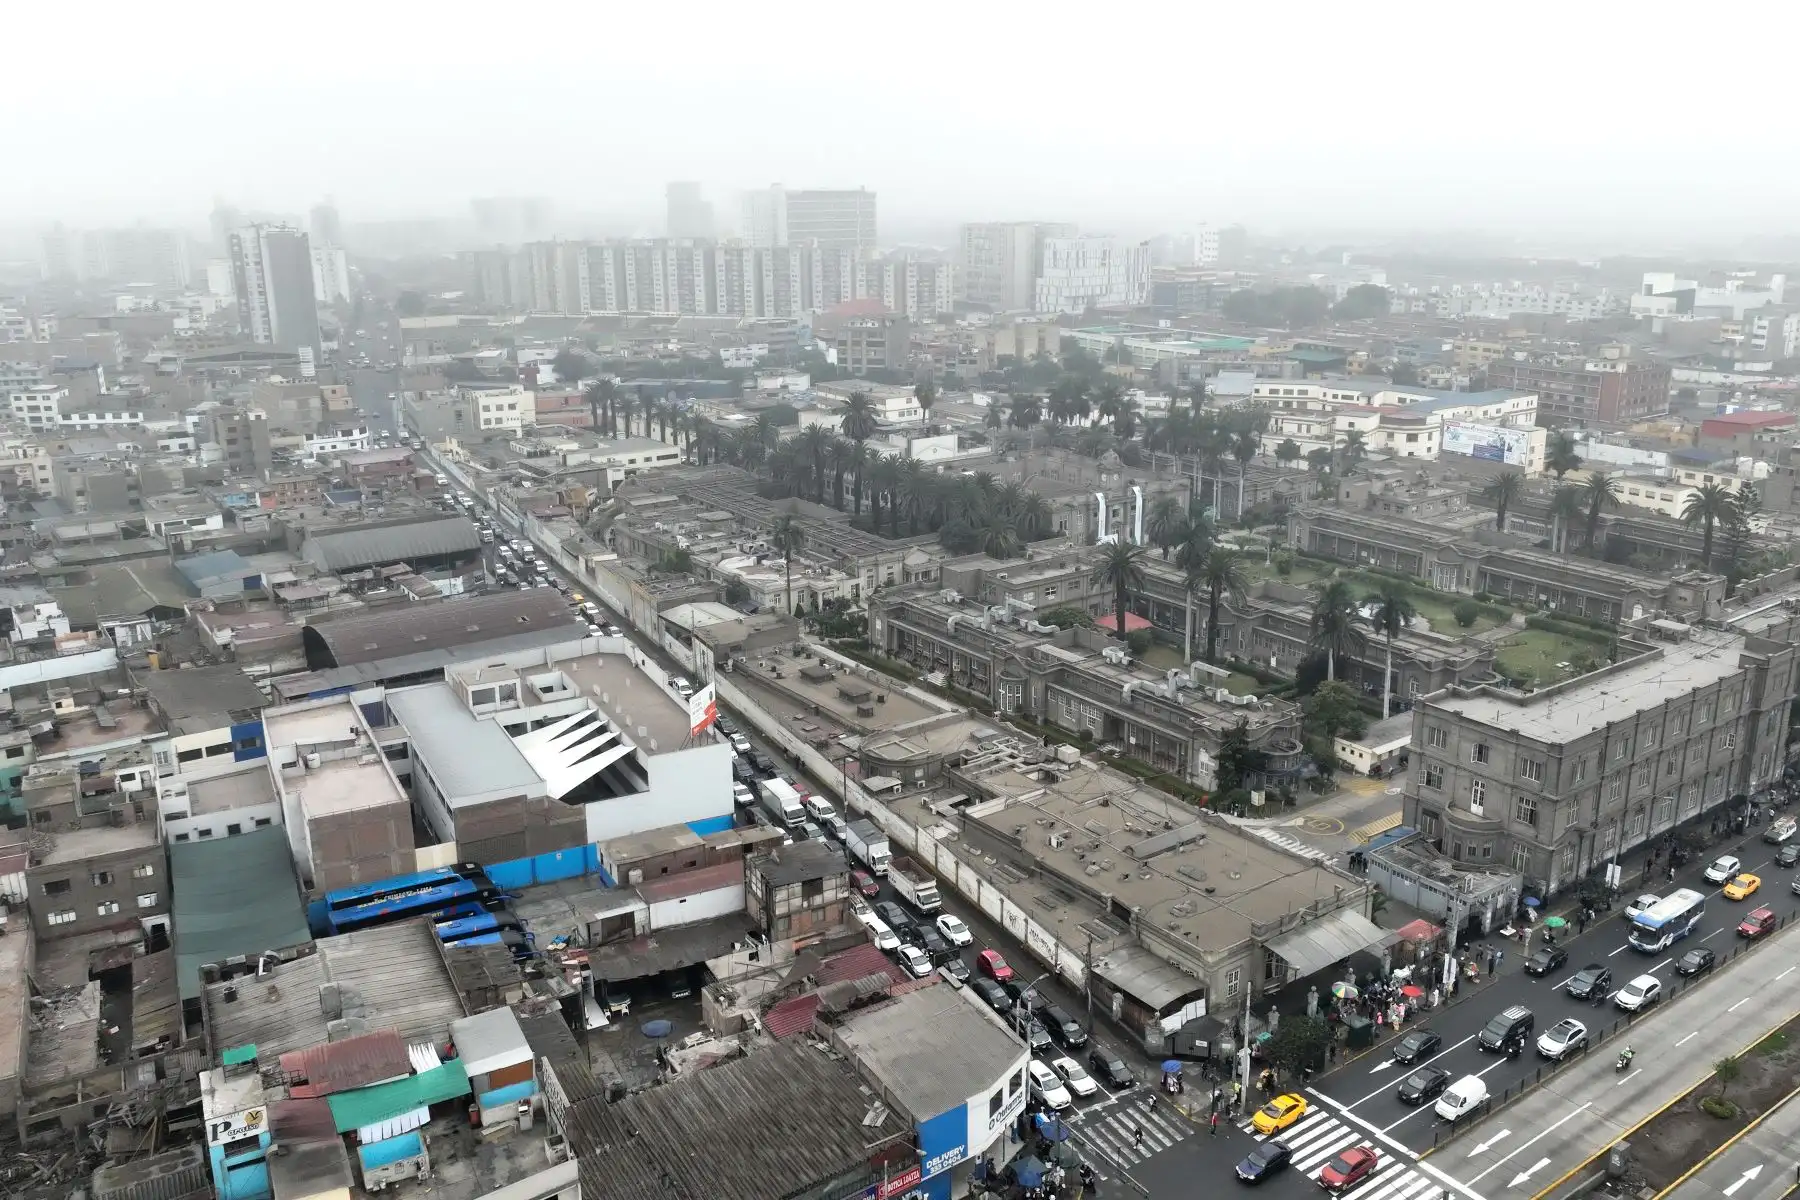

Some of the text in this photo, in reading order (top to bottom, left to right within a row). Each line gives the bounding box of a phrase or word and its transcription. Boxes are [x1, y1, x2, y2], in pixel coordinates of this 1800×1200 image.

[926, 1145, 965, 1169] DELIVERY
[930, 1154, 961, 1174] 333 0404
